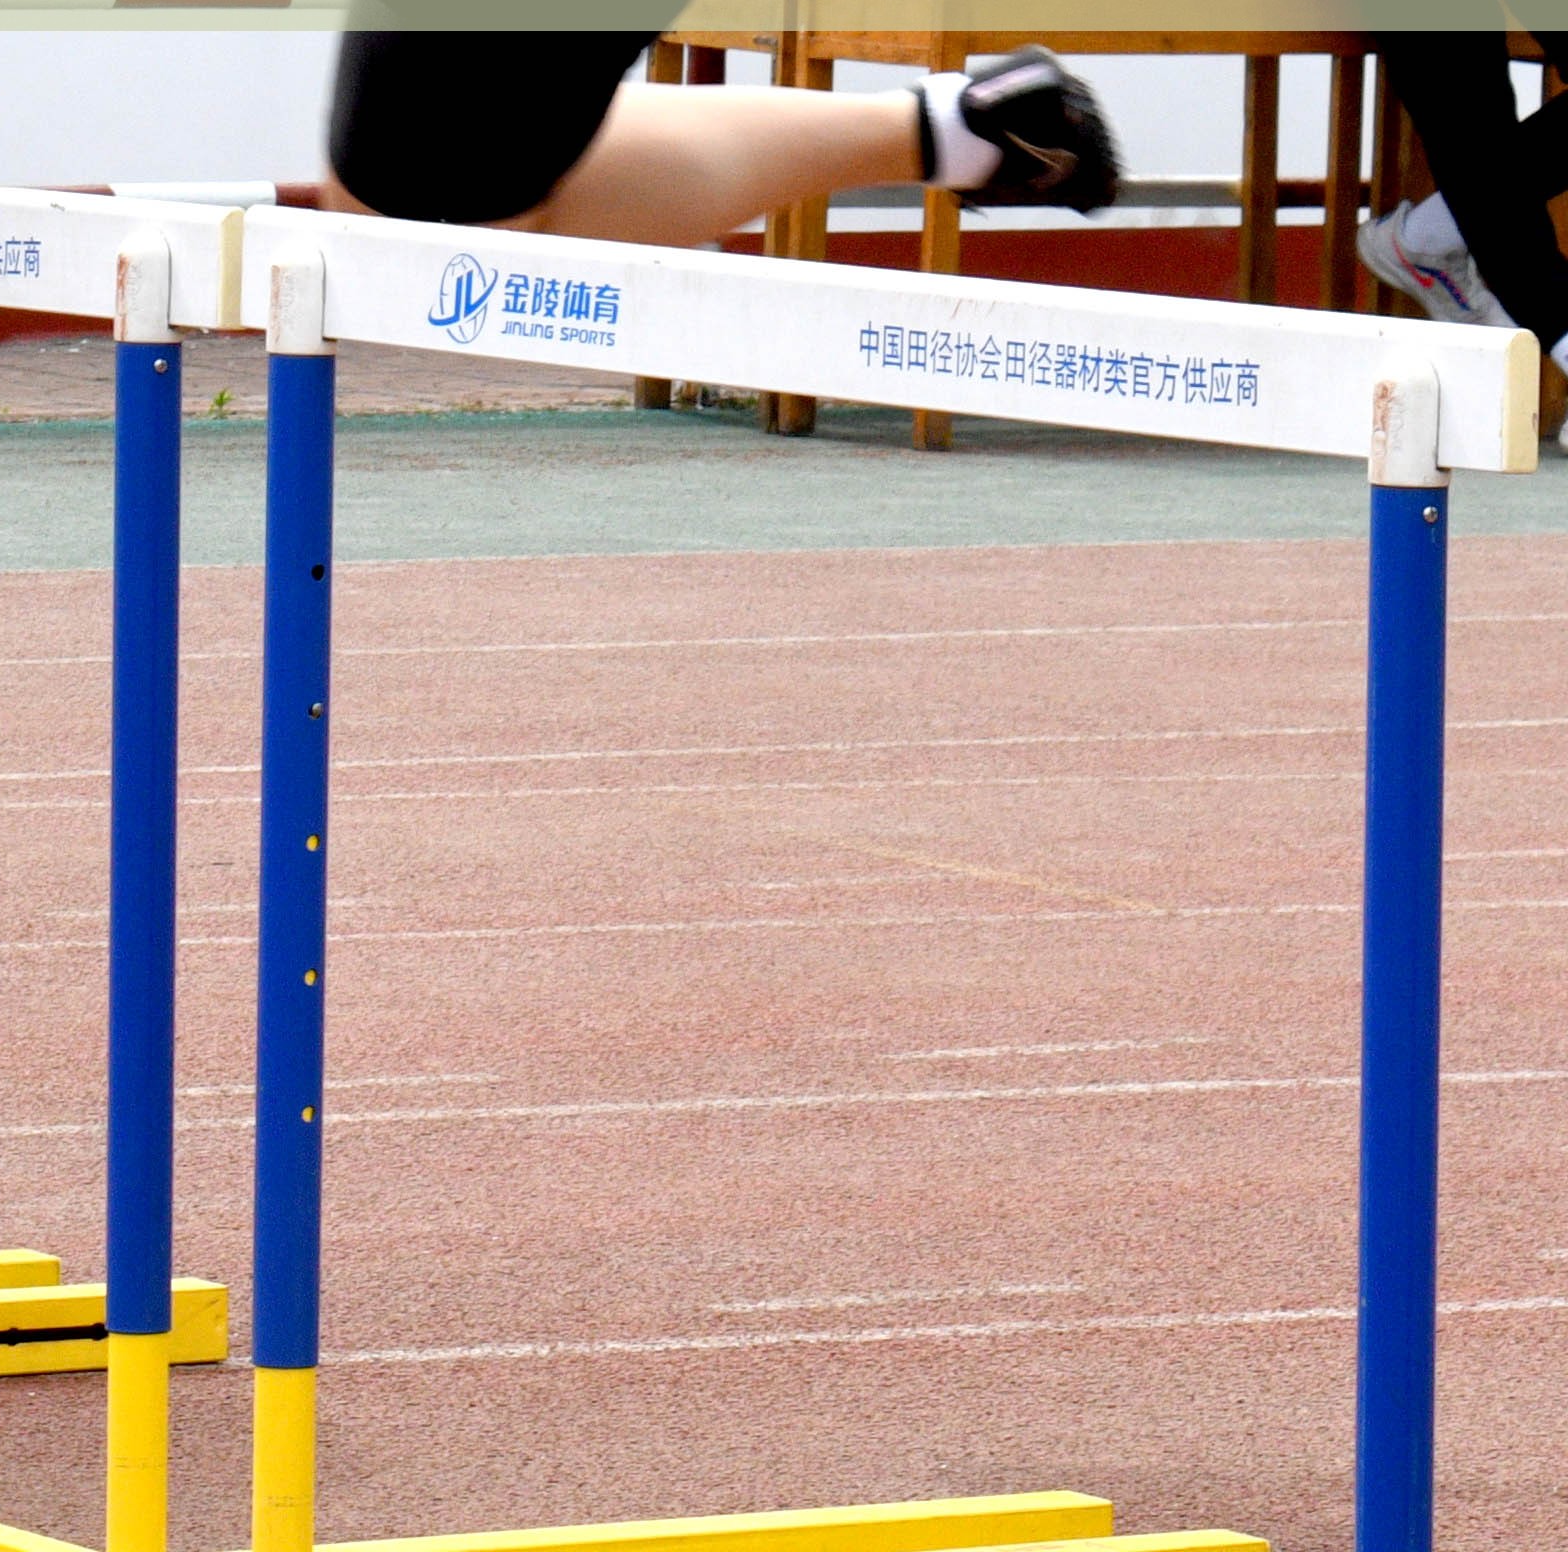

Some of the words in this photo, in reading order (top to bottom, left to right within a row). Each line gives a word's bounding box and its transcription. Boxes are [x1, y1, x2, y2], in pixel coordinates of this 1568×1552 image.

[501, 273, 622, 325] 金陵体育
[501, 321, 554, 340] JINLING
[560, 326, 615, 347] SPORTS
[858, 320, 1261, 409] 中国田径协会田径器材类官方供应商
